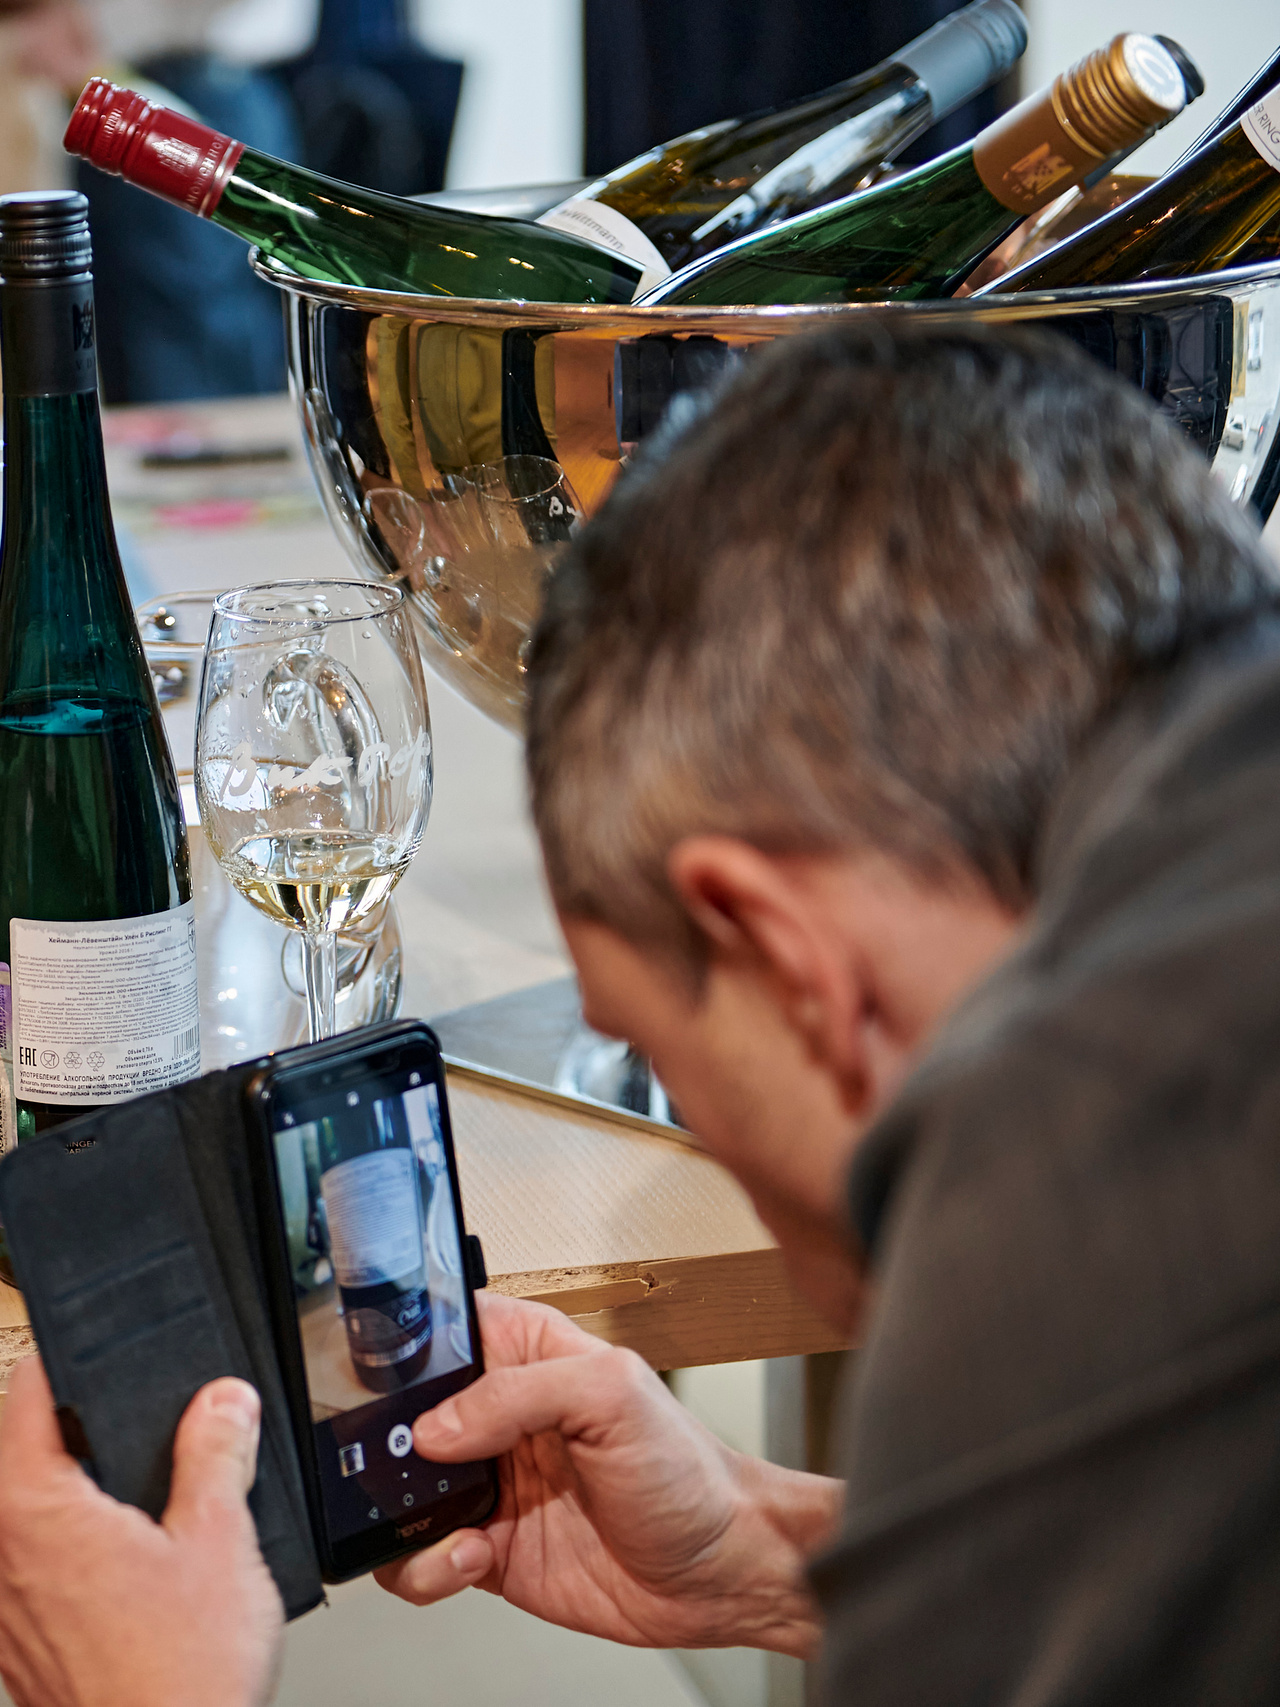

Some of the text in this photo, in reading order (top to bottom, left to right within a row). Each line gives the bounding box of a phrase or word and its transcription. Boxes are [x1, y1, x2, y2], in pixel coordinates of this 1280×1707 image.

[19, 1046, 37, 1066] EAC
[20, 1071, 60, 1081] УПОТРЕБЛЕНИЕ
[108, 1071, 140, 1081] ПРОДУКЦИИ
[142, 1067, 161, 1077] ВРЕДНО
[20, 1079, 40, 1087] Алкоголь
